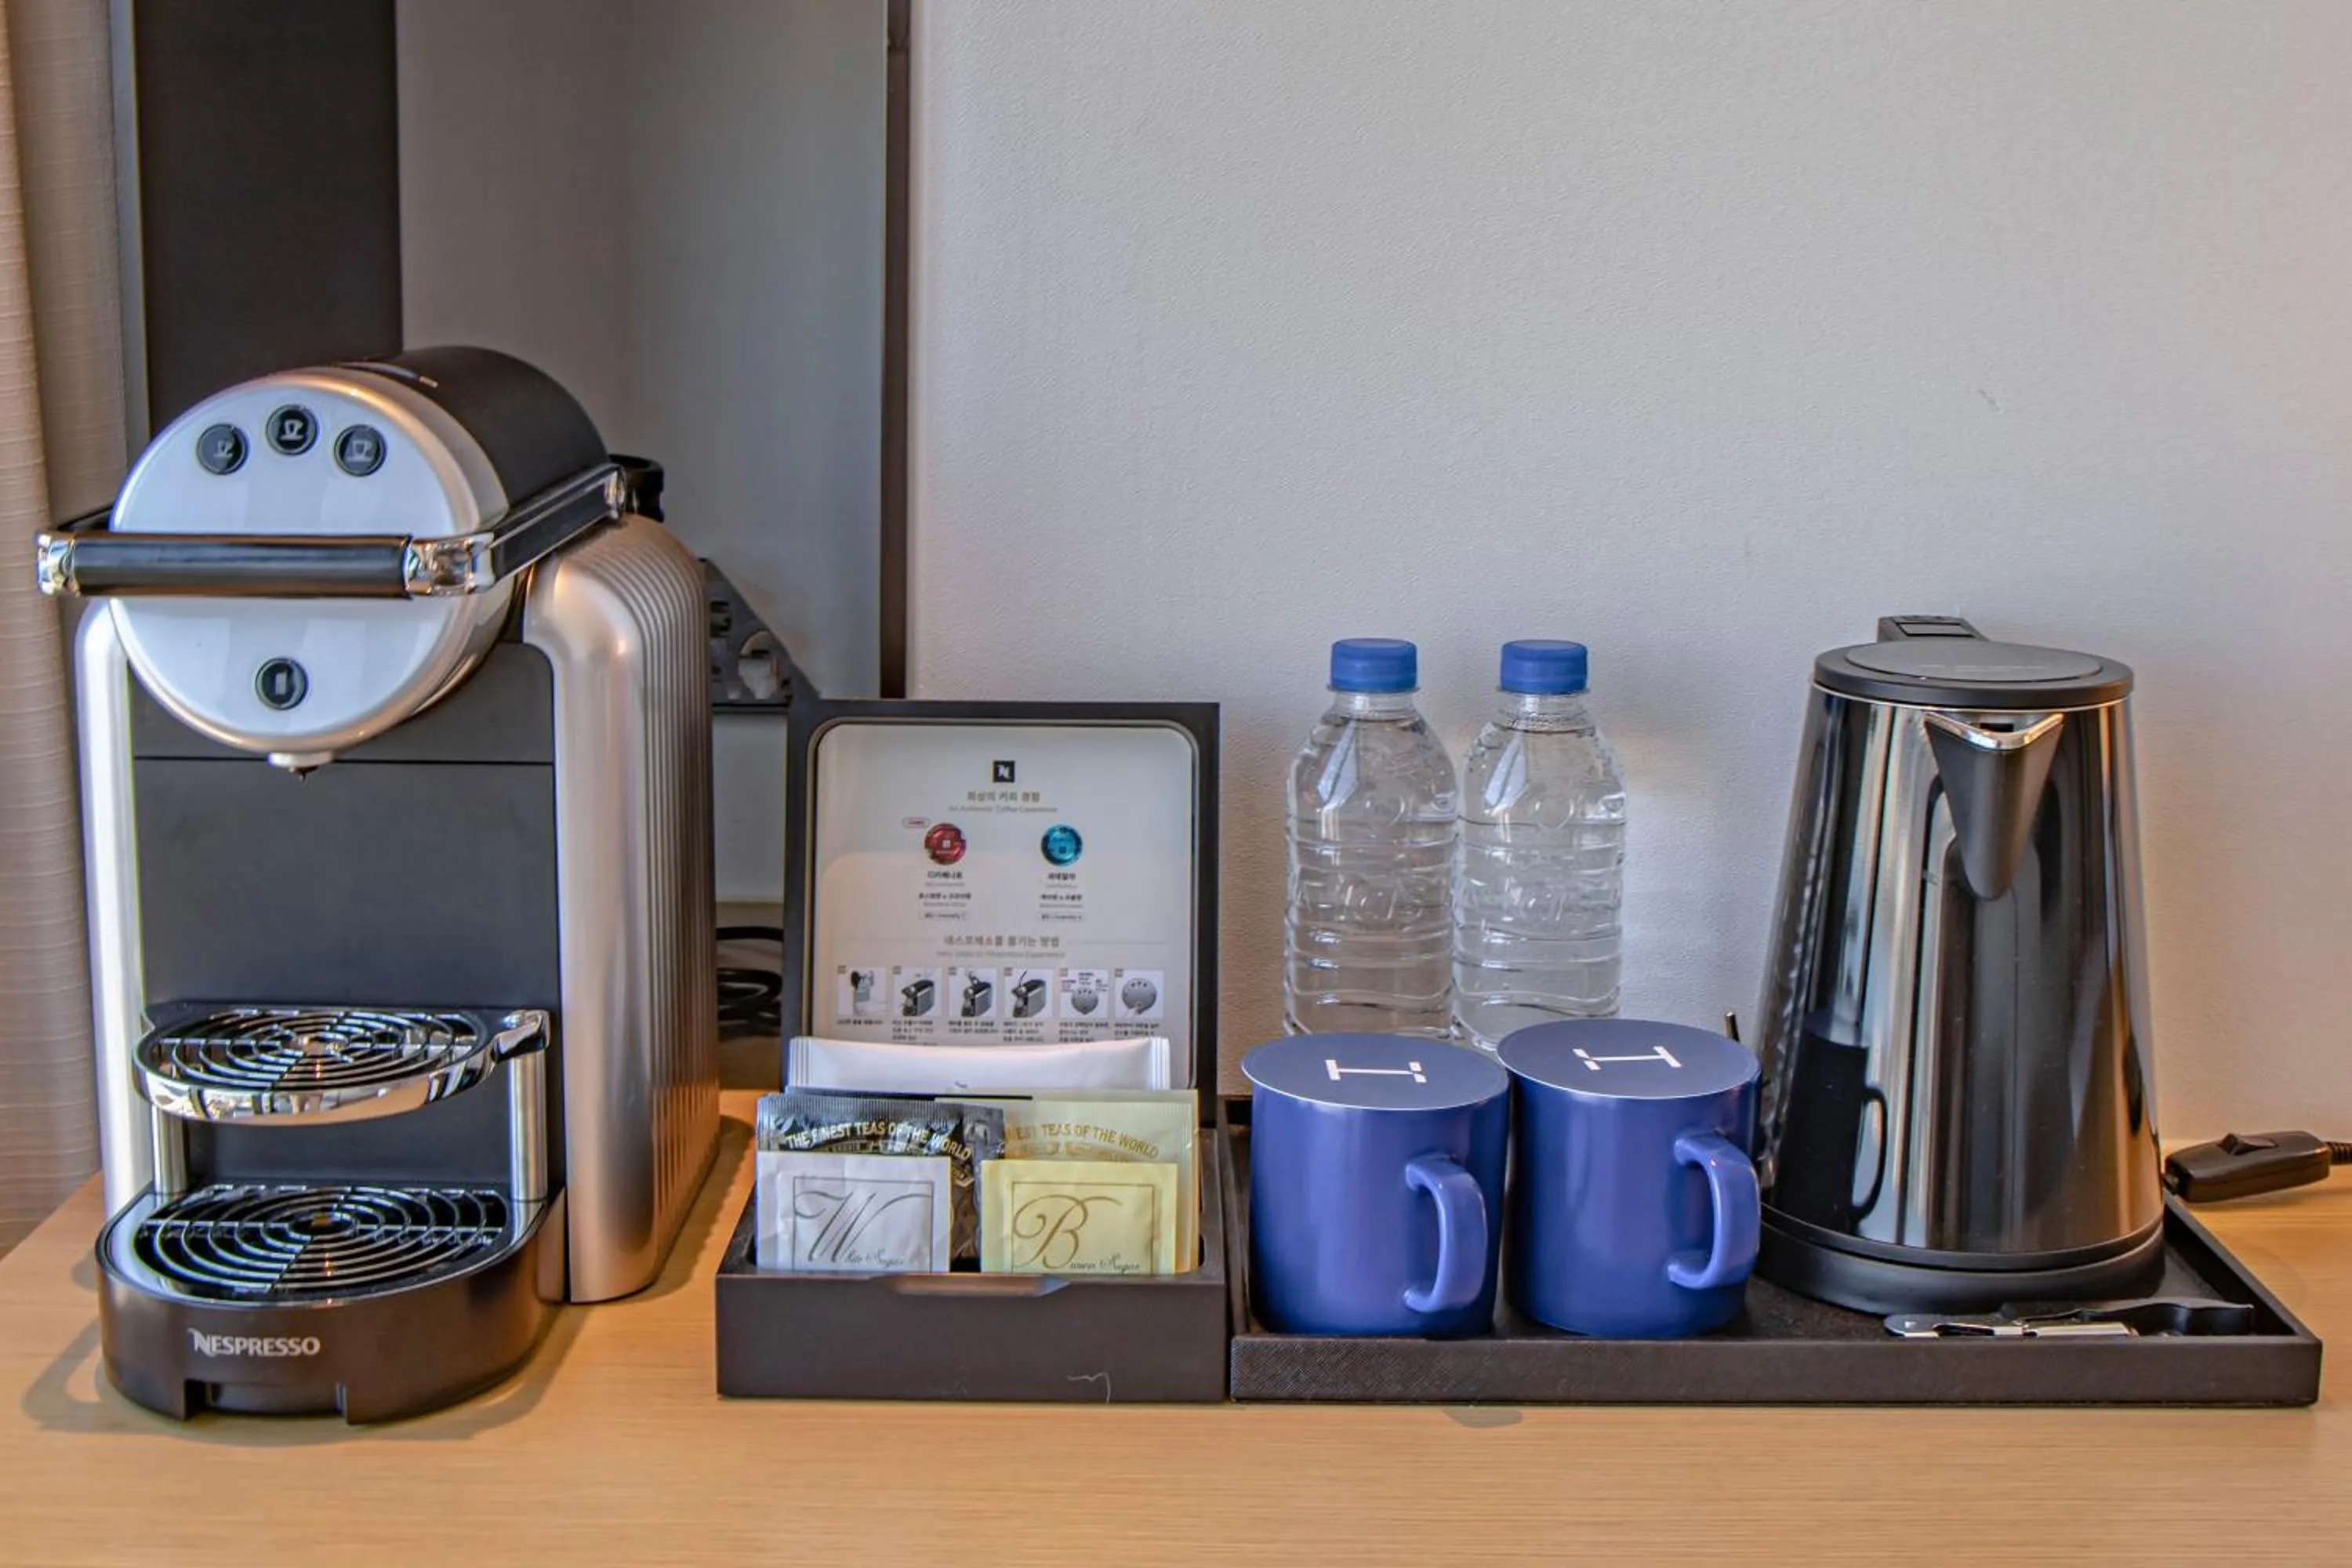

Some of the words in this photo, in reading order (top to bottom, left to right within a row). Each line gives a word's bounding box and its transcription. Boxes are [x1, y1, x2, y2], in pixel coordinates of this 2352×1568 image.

[786, 1132, 811, 1149] THE
[811, 1123, 851, 1145] FINEST
[856, 1121, 886, 1135] TEAS
[887, 1122, 904, 1135] OF
[905, 1124, 929, 1144] THE
[930, 1133, 971, 1160] WORLD
[1040, 1123, 1071, 1137] TEAS
[1076, 1124, 1093, 1138] OF
[1093, 1127, 1117, 1144] THE
[1118, 1134, 1160, 1160] WORLD
[187, 1327, 321, 1358] NESPRESSO
